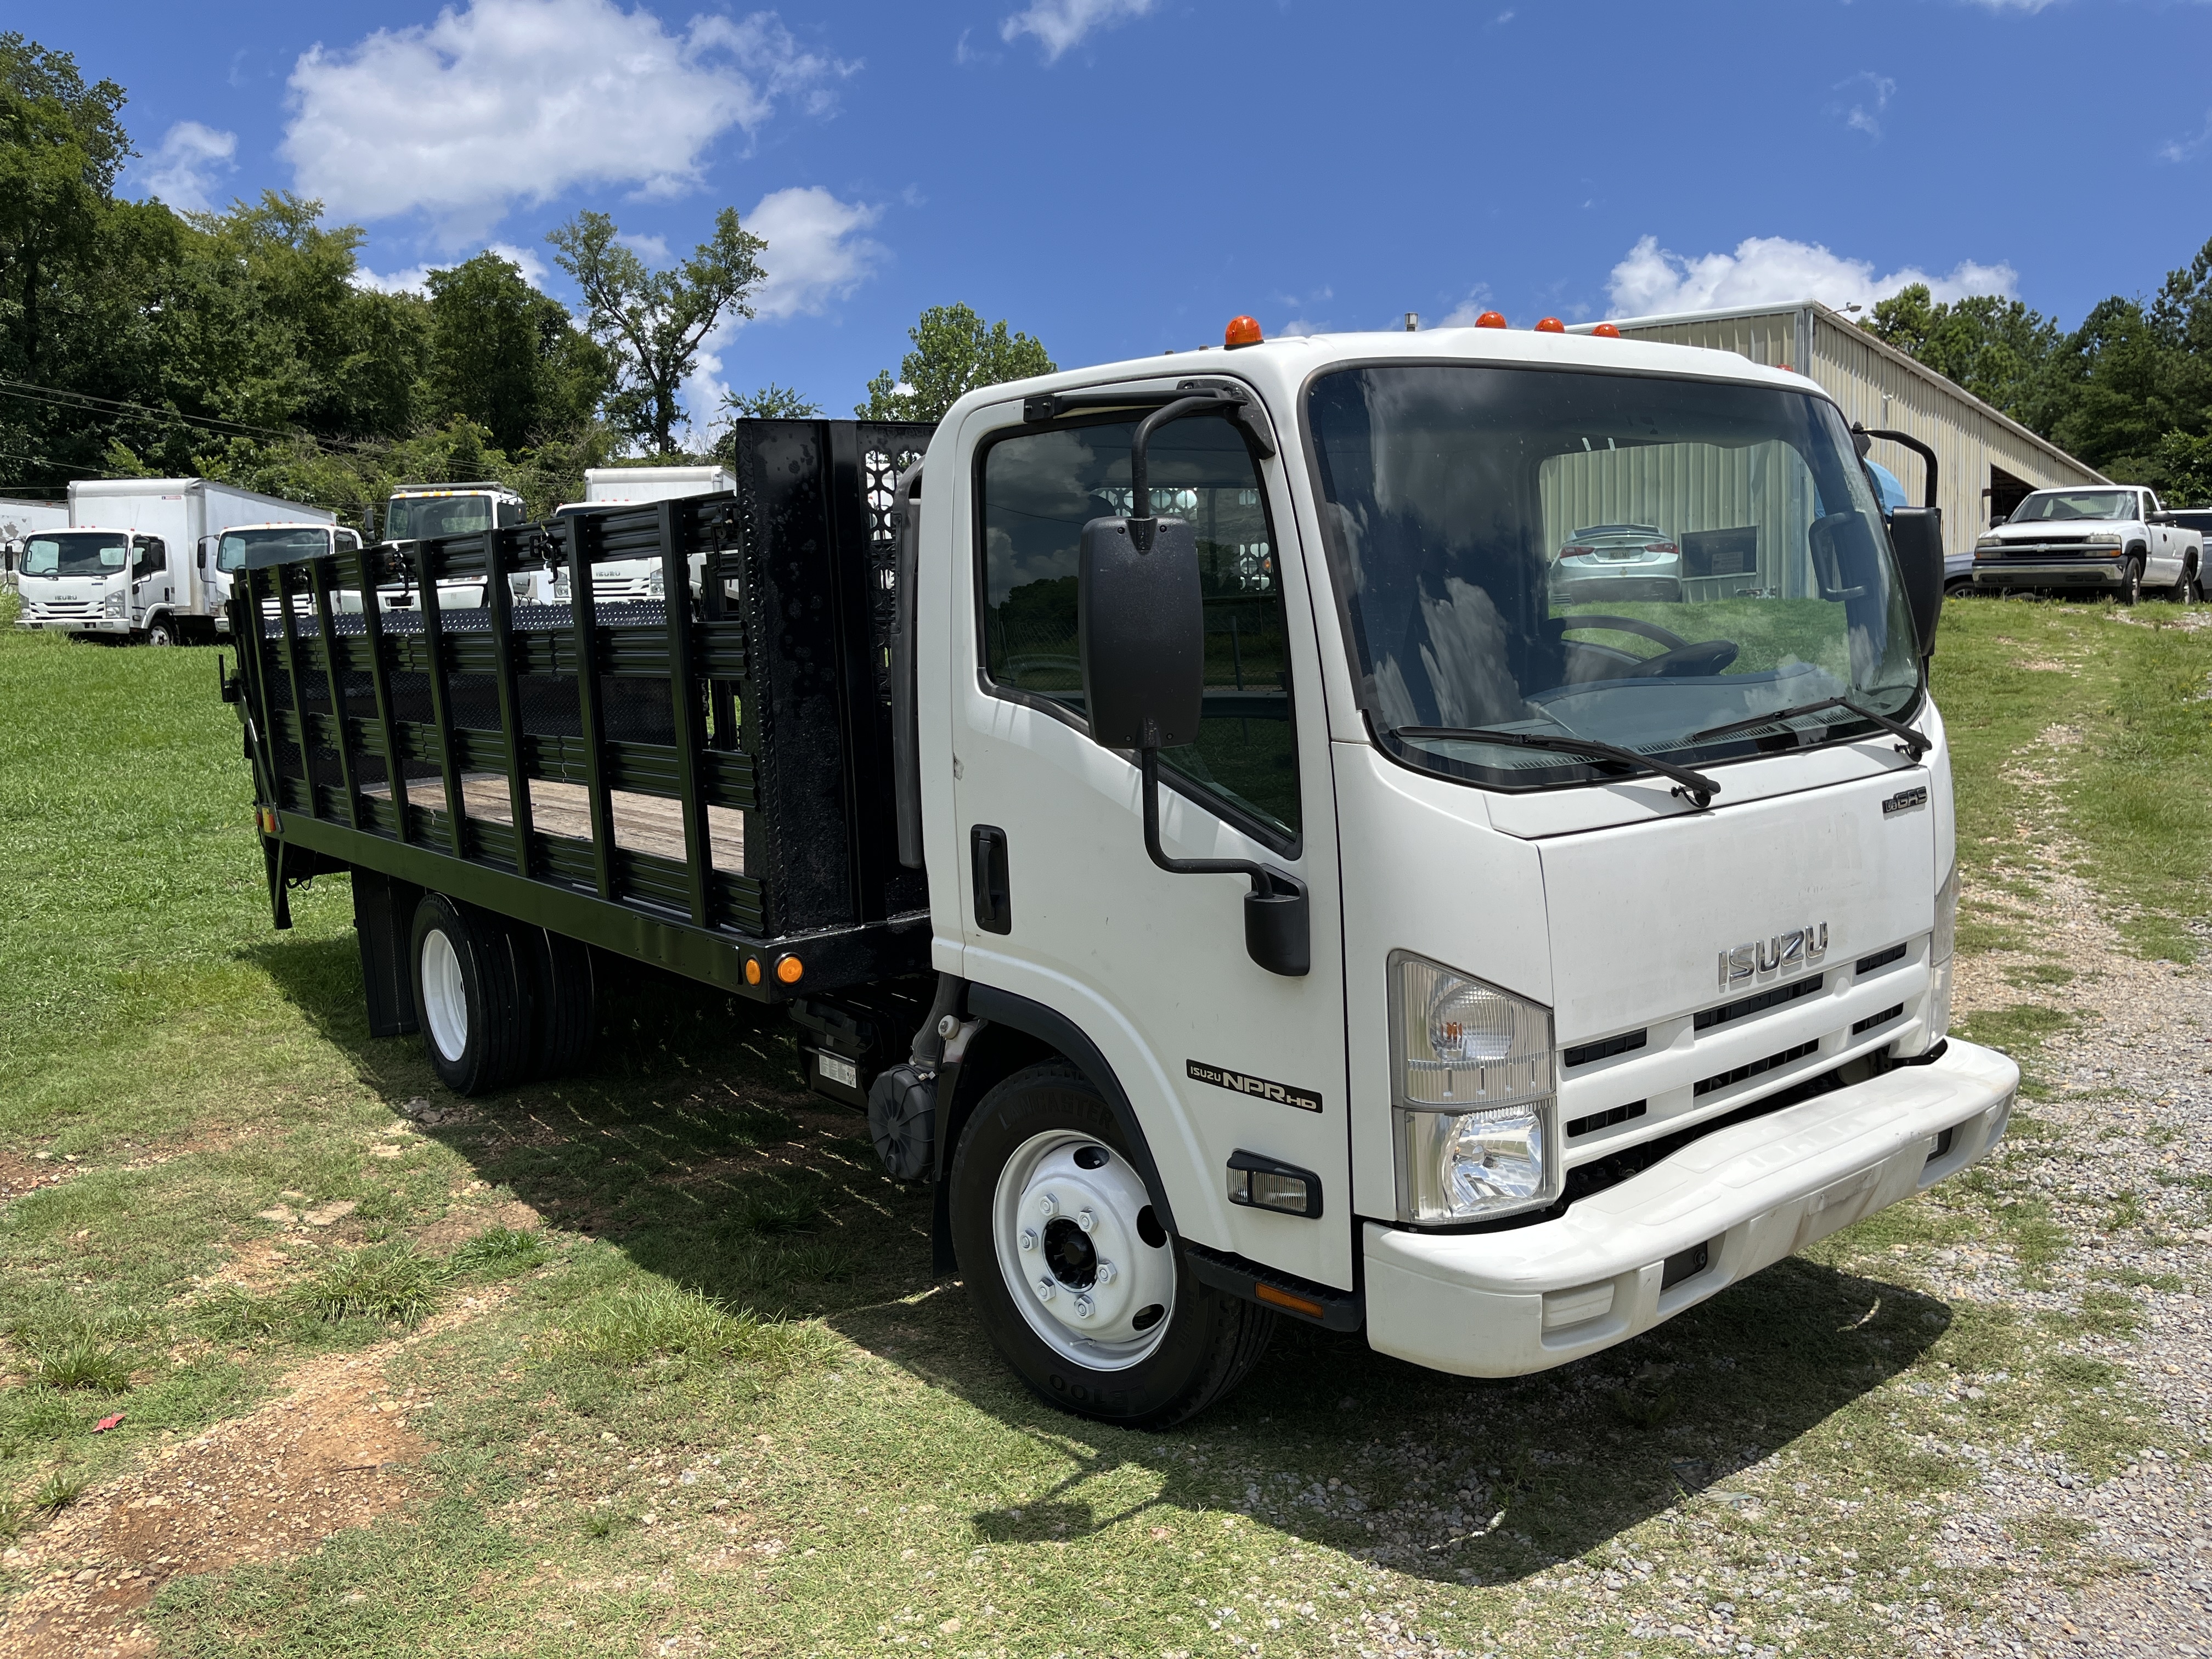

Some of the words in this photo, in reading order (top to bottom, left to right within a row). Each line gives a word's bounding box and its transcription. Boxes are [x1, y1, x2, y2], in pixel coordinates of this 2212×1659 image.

[1719, 921, 1828, 986] ISUZU
[1190, 1066, 1221, 1082] ISUZU
[1223, 1072, 1285, 1102] NPR
[1286, 1095, 1317, 1109] HD
[997, 1090, 1115, 1131] LANCASTER
[1049, 1374, 1151, 1408] LB100
